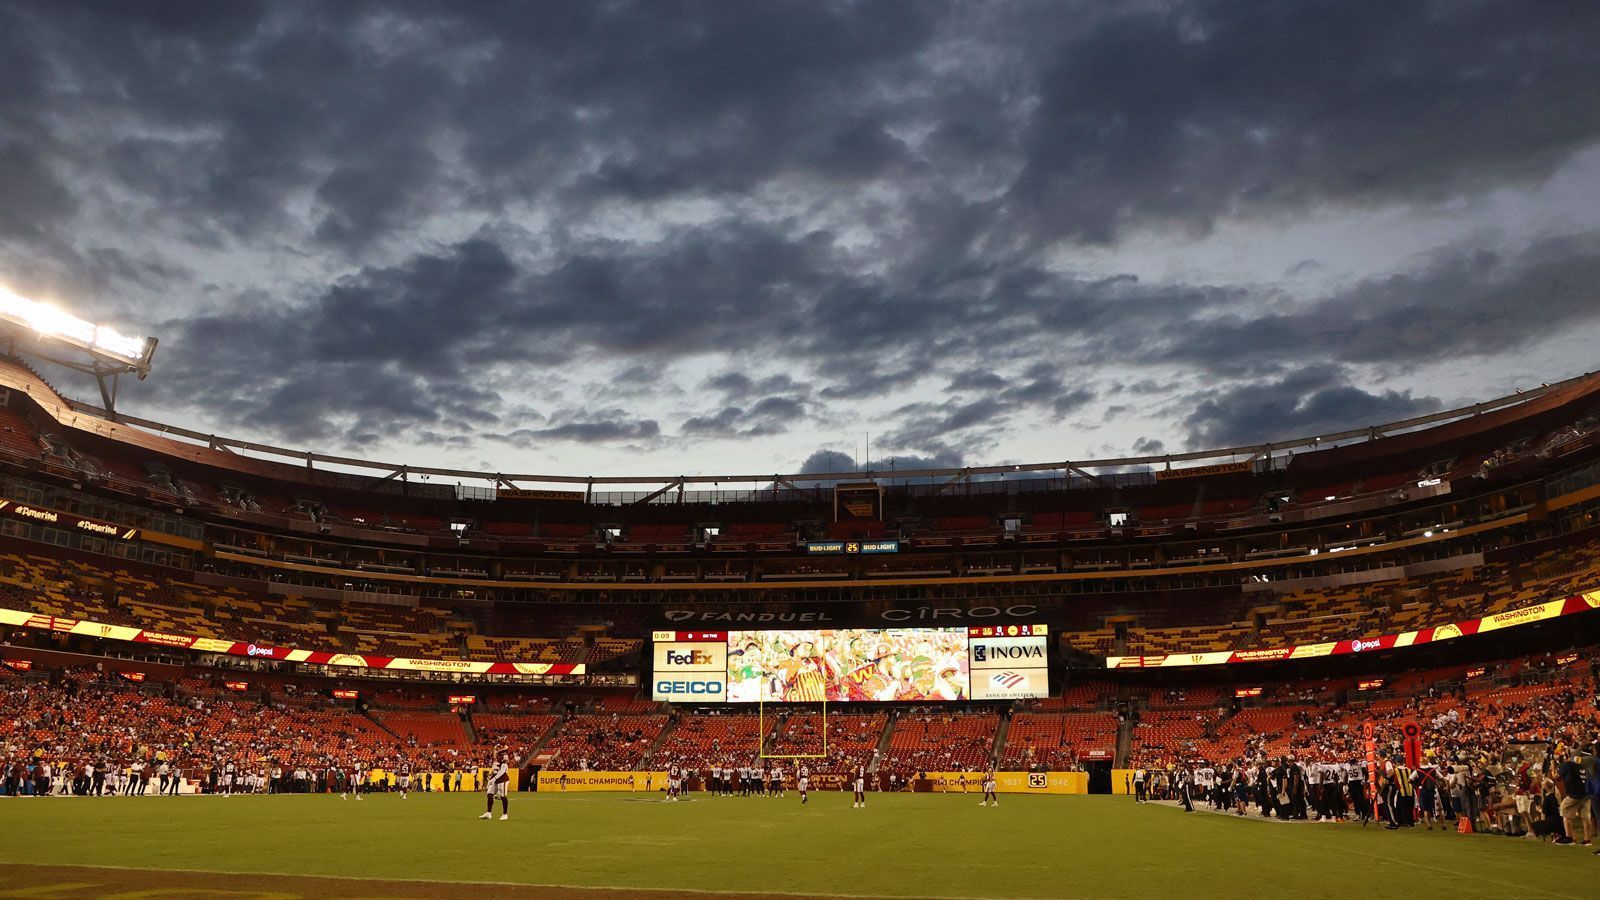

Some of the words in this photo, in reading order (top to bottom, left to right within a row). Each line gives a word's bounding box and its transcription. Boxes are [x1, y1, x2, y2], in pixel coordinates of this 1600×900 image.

[1161, 463, 1248, 478] WASHINGTON
[501, 490, 581, 499] WASHINGTON
[847, 544, 858, 552] 25
[700, 612, 833, 622] FANDUEL
[1493, 605, 1546, 623] WASHINGTON
[143, 631, 192, 643] WASHINGTON
[1361, 639, 1381, 650] pepsi
[255, 648, 273, 656] pepsi
[991, 646, 1043, 659] INOVA
[1235, 648, 1290, 658] WASHINGTON
[666, 650, 713, 665] FedEx
[409, 659, 471, 668] WASHINGTON
[656, 681, 722, 694] GEICO
[540, 777, 563, 785] SUPE
[1030, 775, 1044, 785] 25
